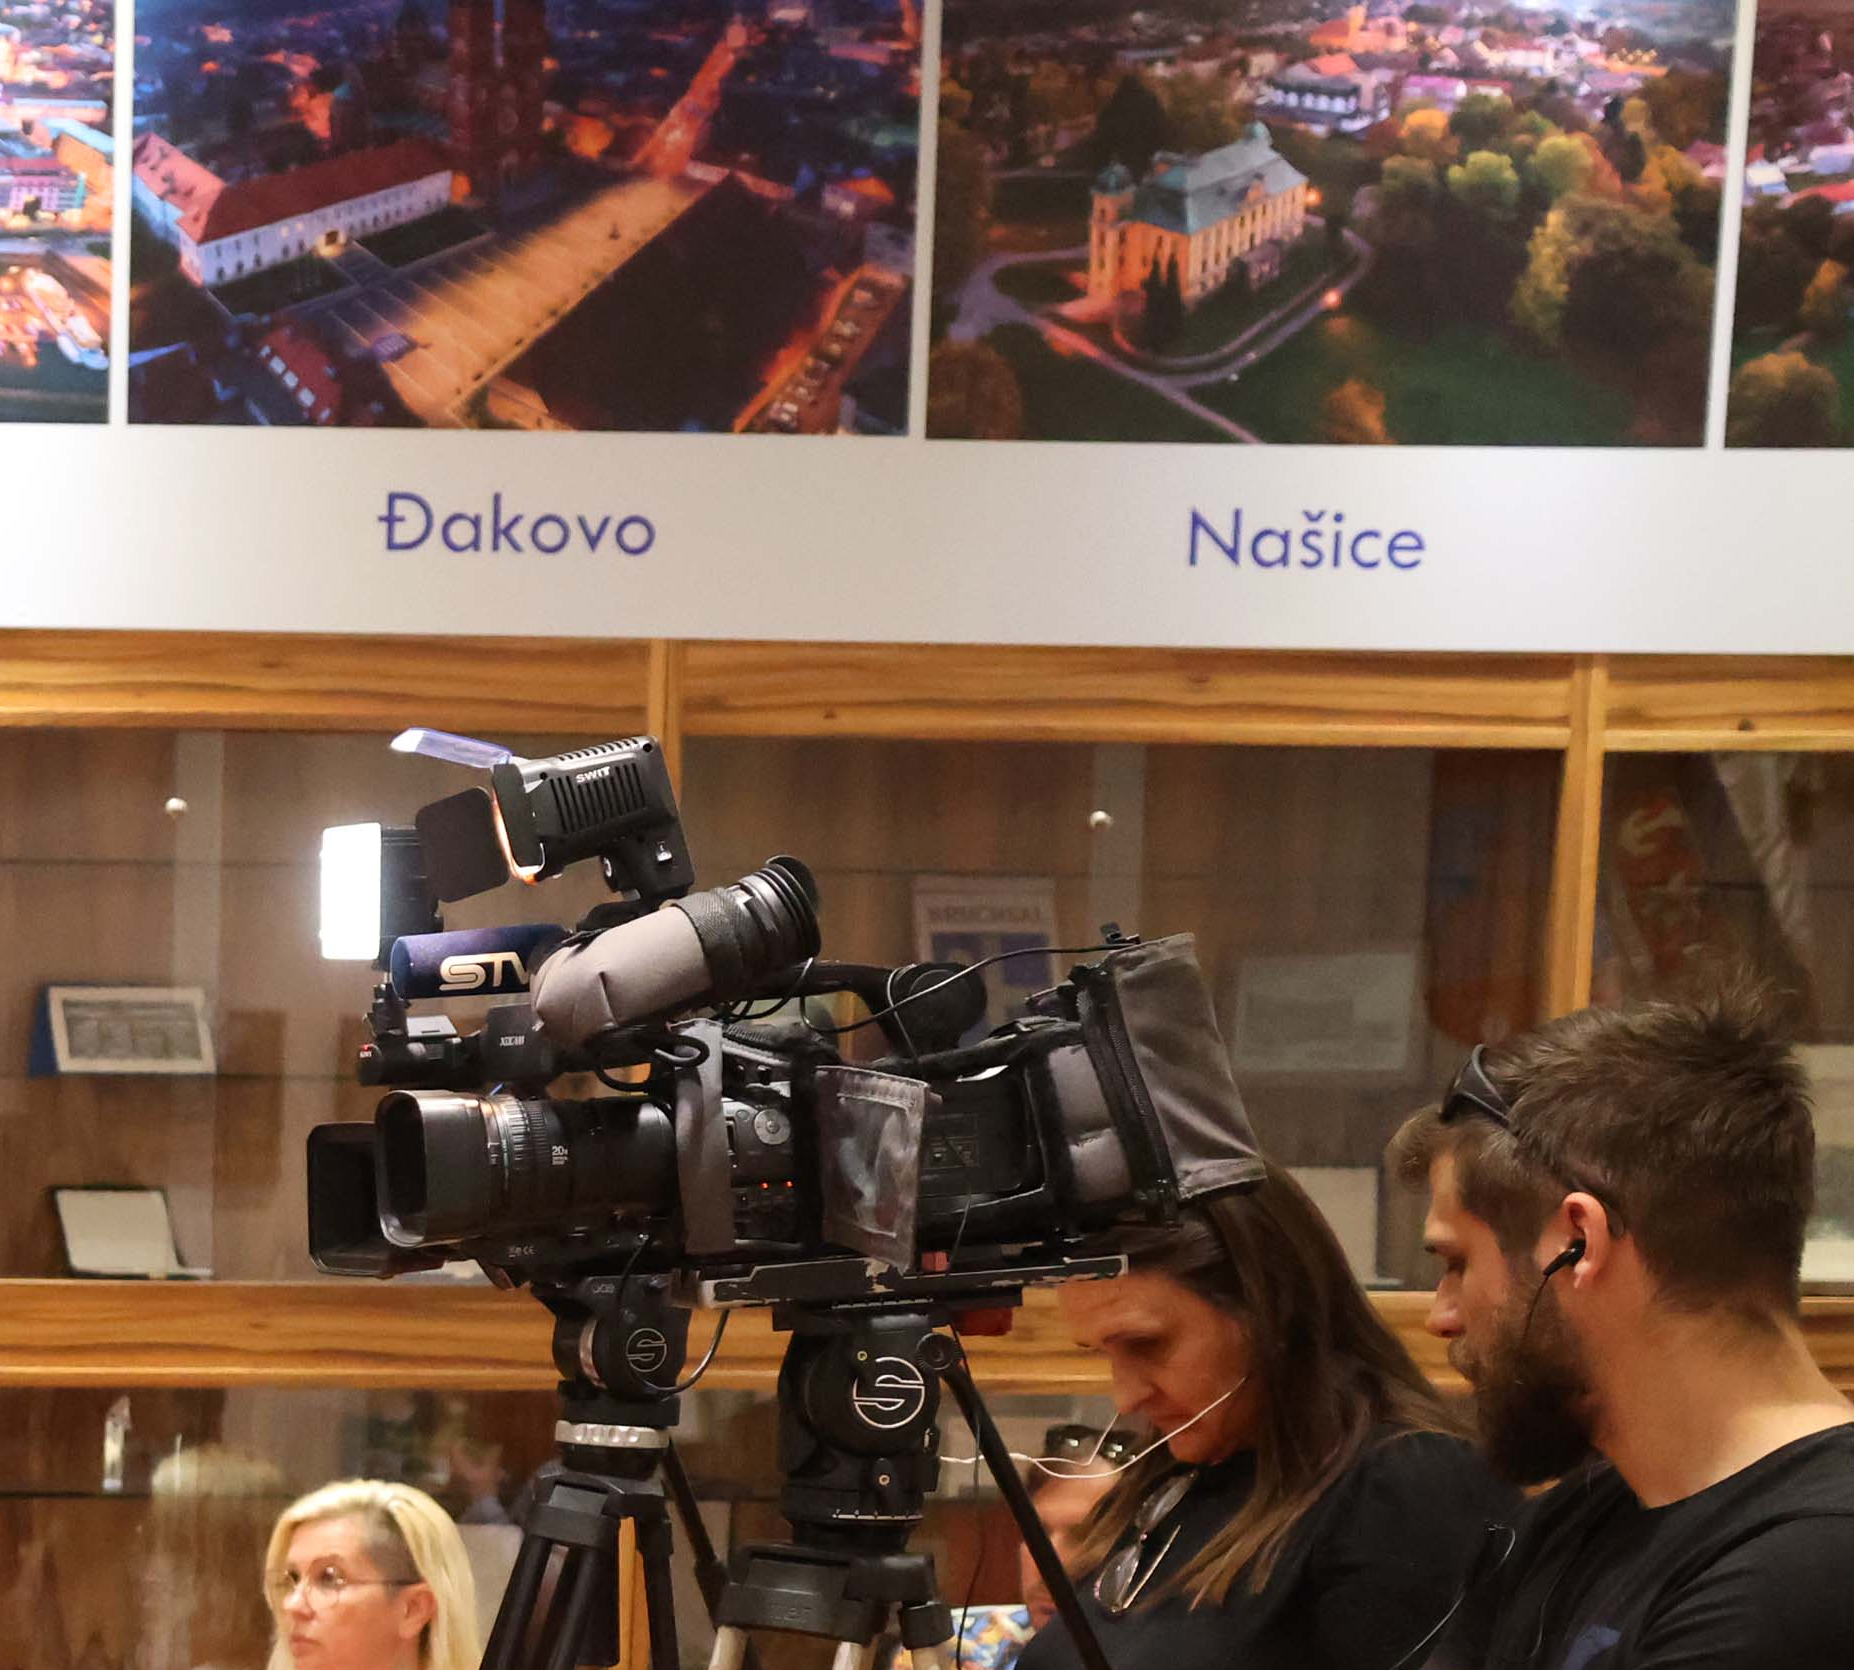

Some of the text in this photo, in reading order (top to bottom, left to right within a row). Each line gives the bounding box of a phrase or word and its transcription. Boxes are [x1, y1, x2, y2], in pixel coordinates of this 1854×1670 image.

[379, 491, 657, 558] Đakovo
[1189, 507, 1428, 573] Našice
[576, 766, 611, 783] SWIT
[439, 951, 531, 991] STV
